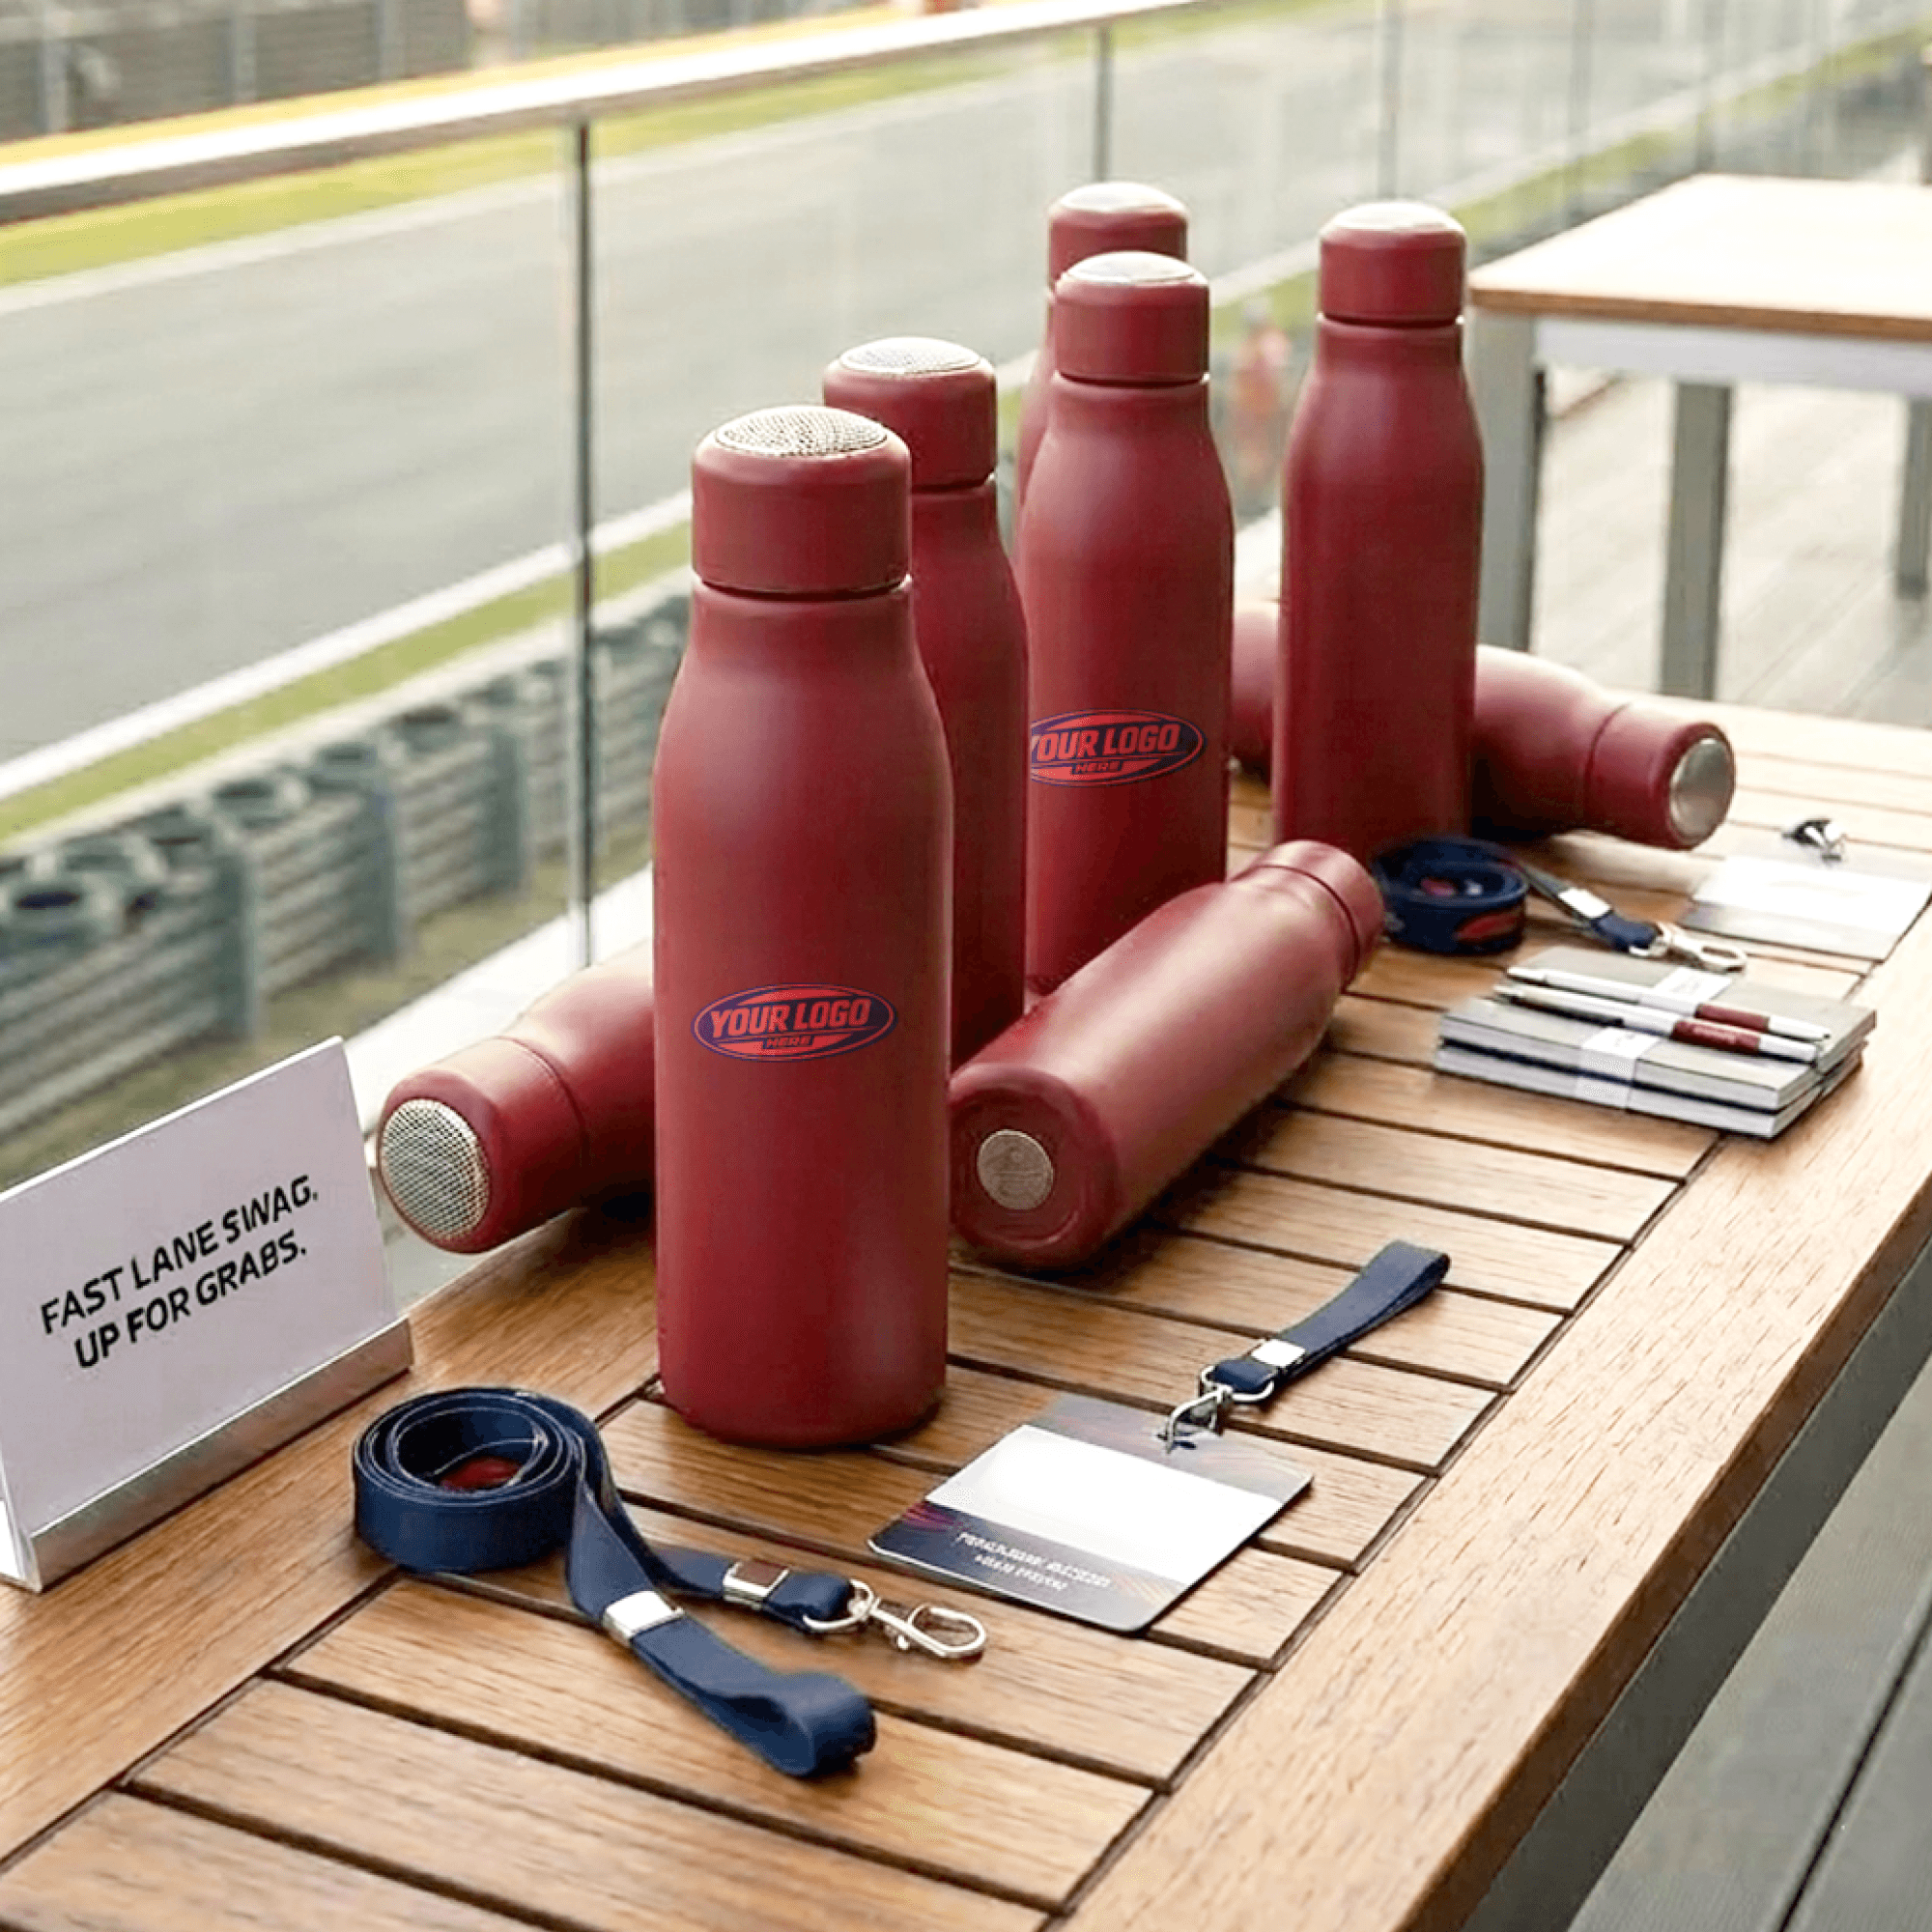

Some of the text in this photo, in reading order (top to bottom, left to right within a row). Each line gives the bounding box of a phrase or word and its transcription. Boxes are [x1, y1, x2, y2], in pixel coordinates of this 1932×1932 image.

[1102, 724, 1180, 755] LOGO
[711, 999, 871, 1038] YOUR LOGO
[41, 1175, 318, 1335] FAST LANE SWAG.
[73, 1228, 306, 1369] UP FOR GRABS.
